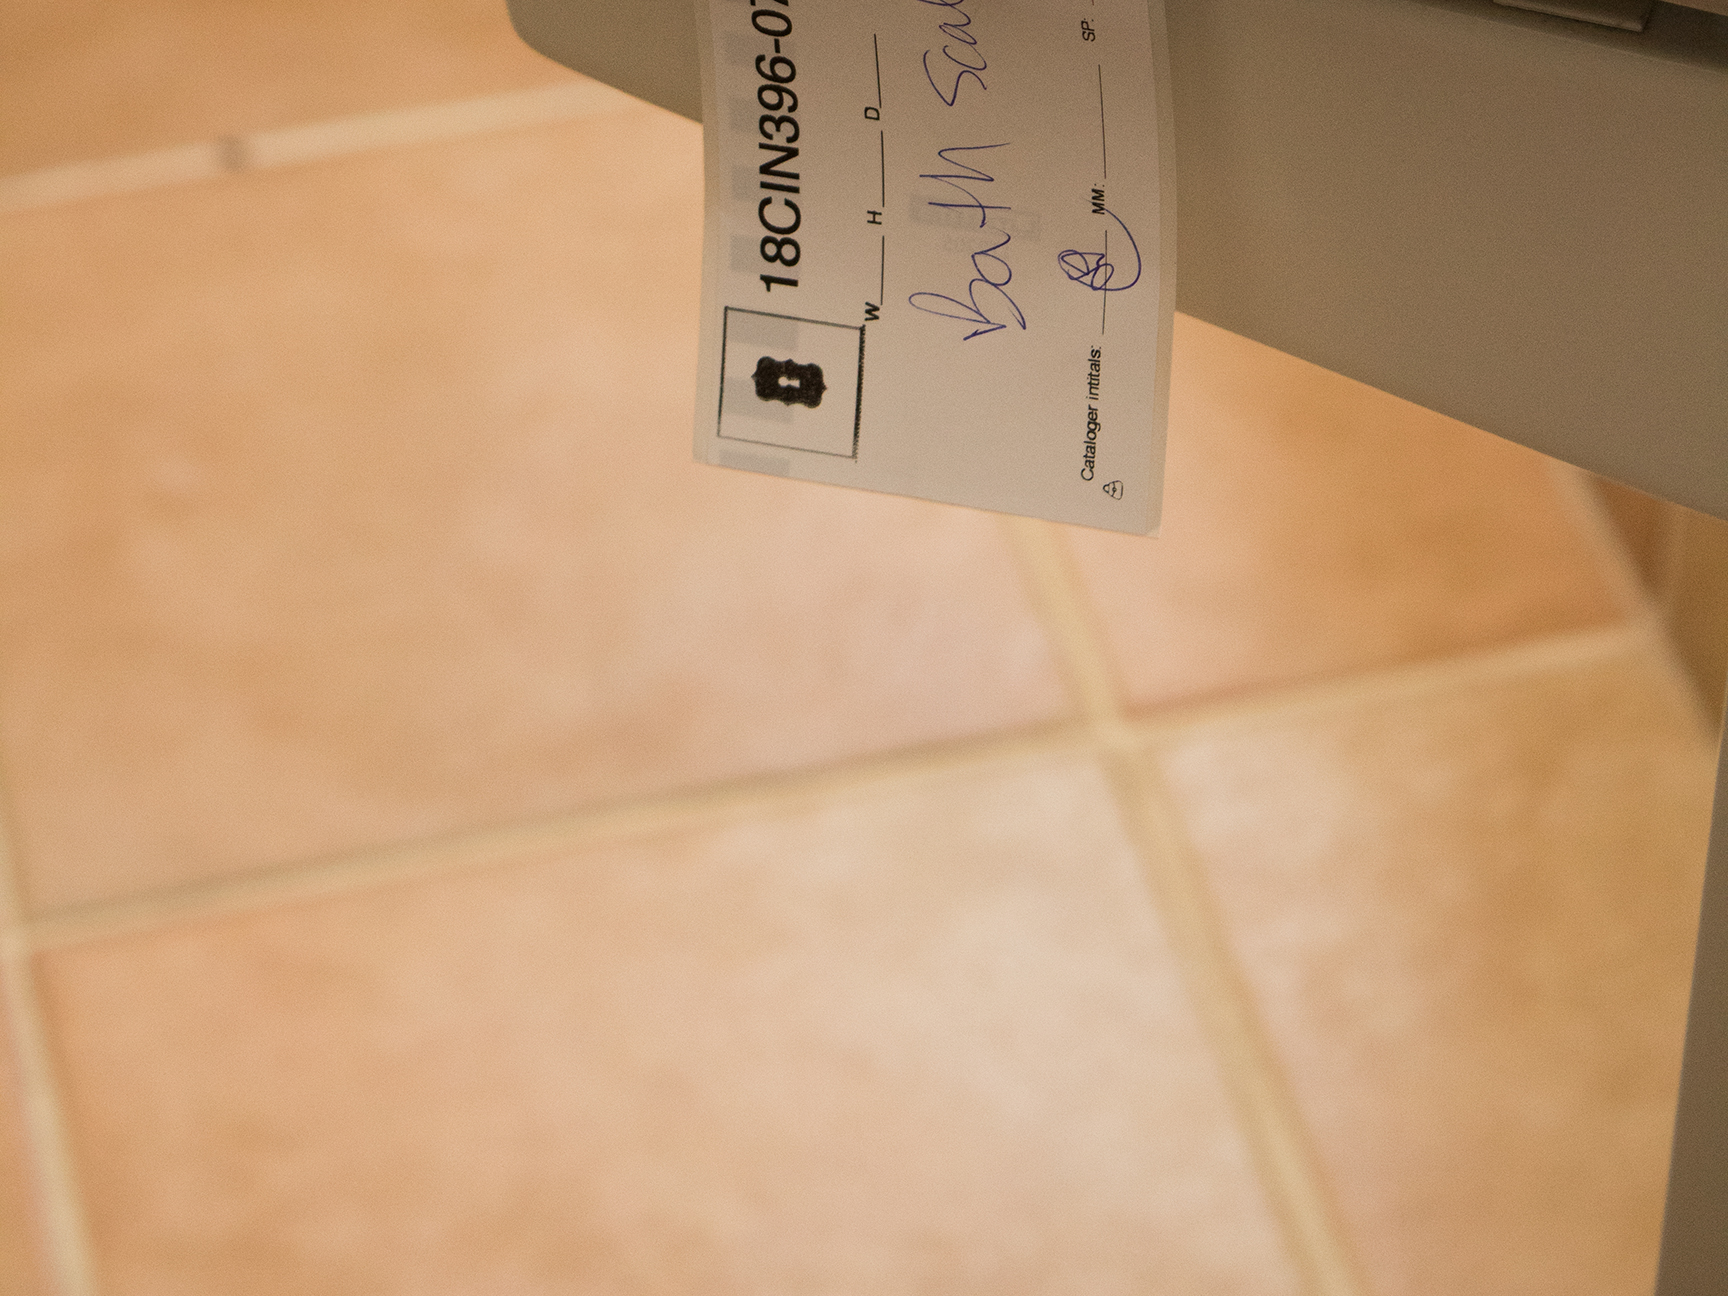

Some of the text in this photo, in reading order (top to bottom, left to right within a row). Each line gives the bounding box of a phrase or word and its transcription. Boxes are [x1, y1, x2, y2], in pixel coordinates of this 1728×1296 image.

[864, 107, 882, 322] W H D
[1080, 17, 1106, 482] Cataloger intitals: MM: SP:
